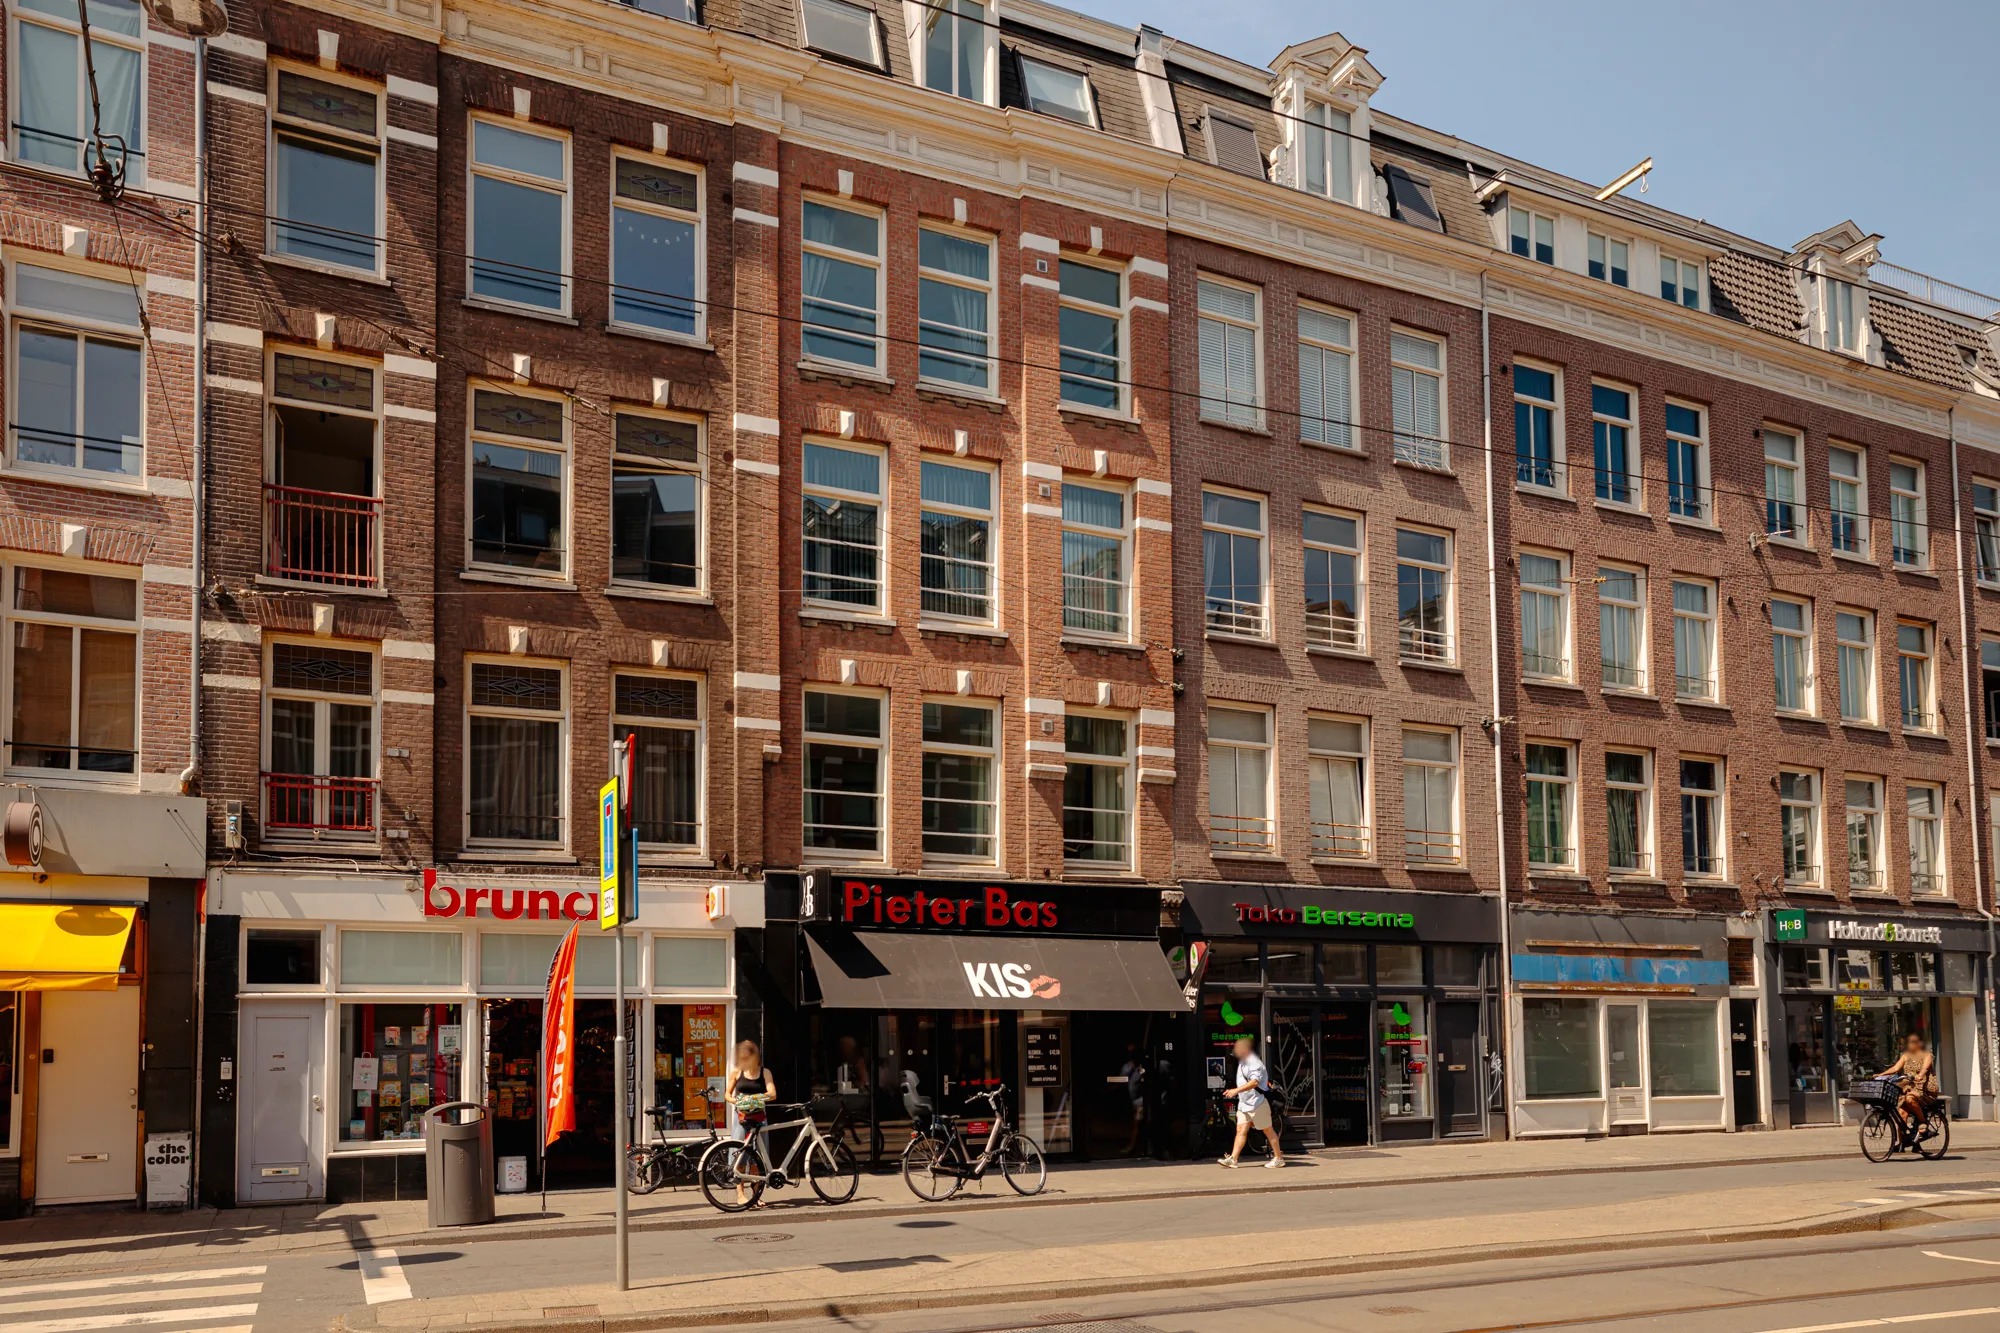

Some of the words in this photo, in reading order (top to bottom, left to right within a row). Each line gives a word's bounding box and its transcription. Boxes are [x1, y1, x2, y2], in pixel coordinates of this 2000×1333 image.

[424, 868, 598, 921] bruna
[844, 881, 975, 926] Pieter
[985, 886, 1059, 928] Bas
[1232, 902, 1297, 924] Toko
[1303, 905, 1416, 929] Bersama
[688, 1018, 713, 1030] BACK
[690, 1029, 721, 1041] SCHOOL
[158, 1144, 186, 1154] the
[147, 1154, 189, 1165] color
